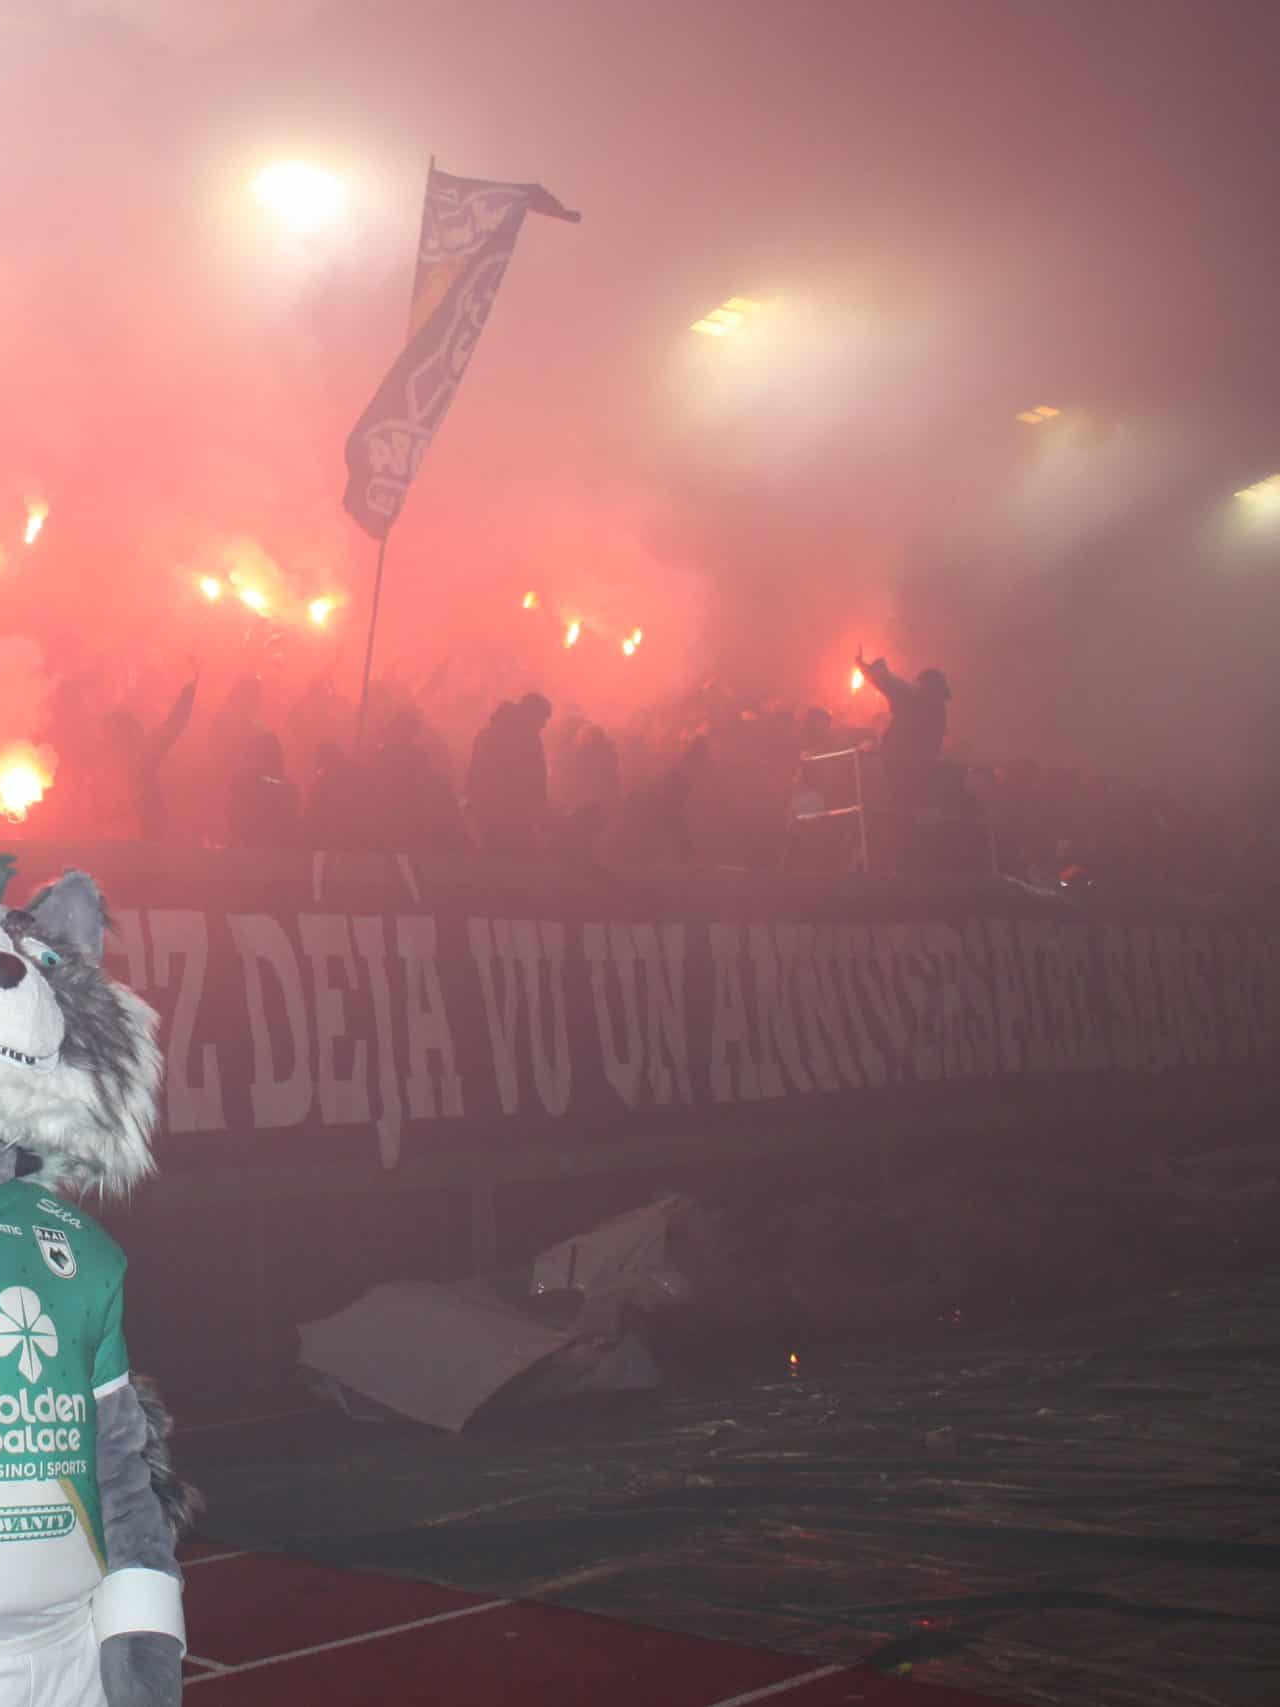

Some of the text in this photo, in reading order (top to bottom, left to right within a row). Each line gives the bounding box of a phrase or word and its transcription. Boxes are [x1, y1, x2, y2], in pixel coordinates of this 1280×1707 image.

[466, 916, 573, 1117] VU
[582, 921, 693, 1109] UN
[36, 1197, 83, 1230] Sita
[47, 1459, 88, 1476] SPORTS
